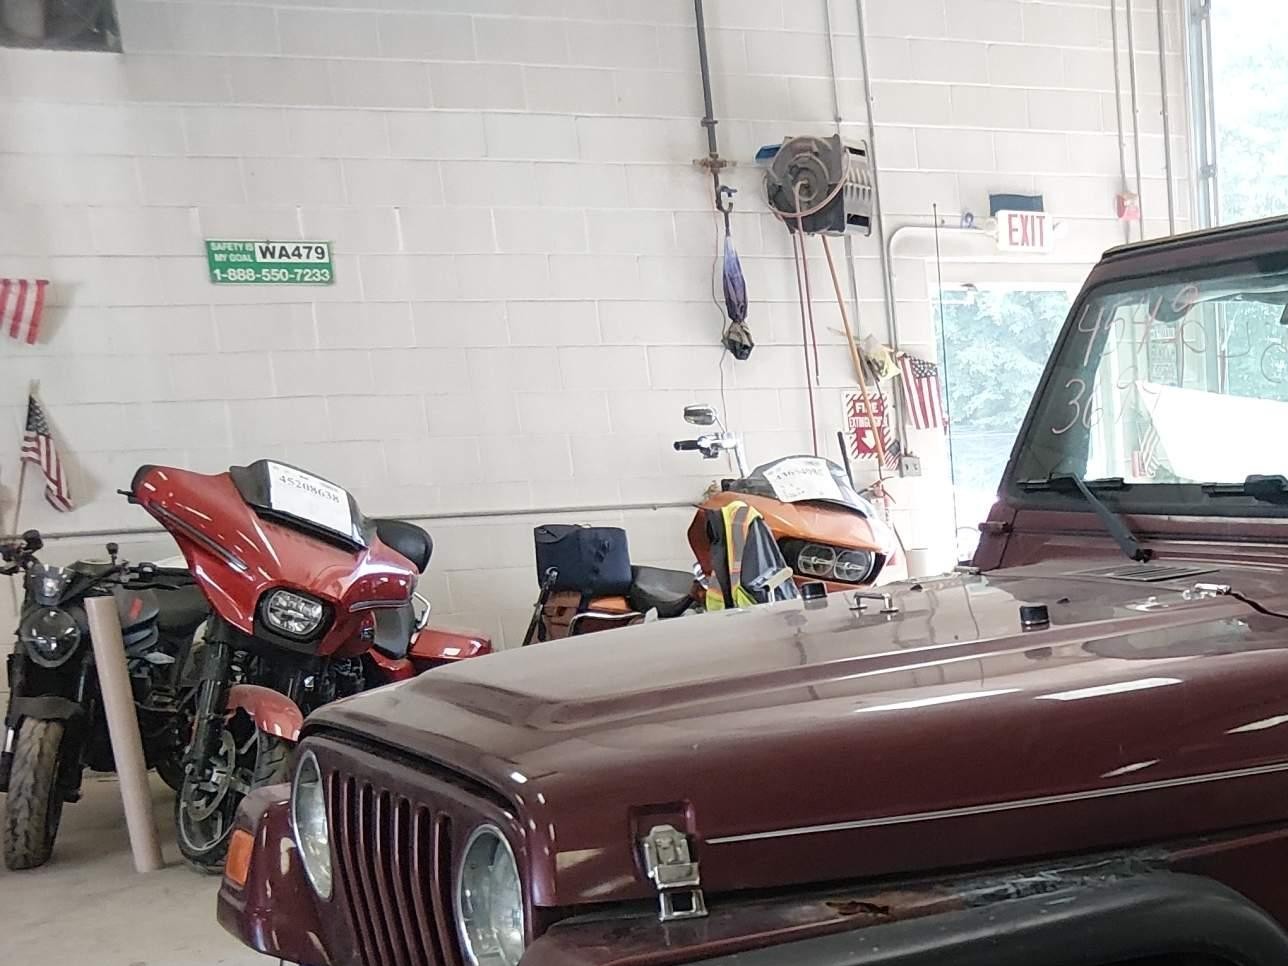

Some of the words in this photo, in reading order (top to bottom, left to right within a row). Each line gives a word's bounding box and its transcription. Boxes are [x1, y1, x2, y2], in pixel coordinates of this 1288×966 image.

[1007, 214, 1046, 247] EXIT
[210, 243, 244, 251] SAFETY
[258, 245, 326, 260] WA479
[214, 253, 227, 262] MY
[229, 254, 254, 262] GOAL
[212, 268, 331, 281] 1-888-550-7233
[855, 402, 879, 414] FIE
